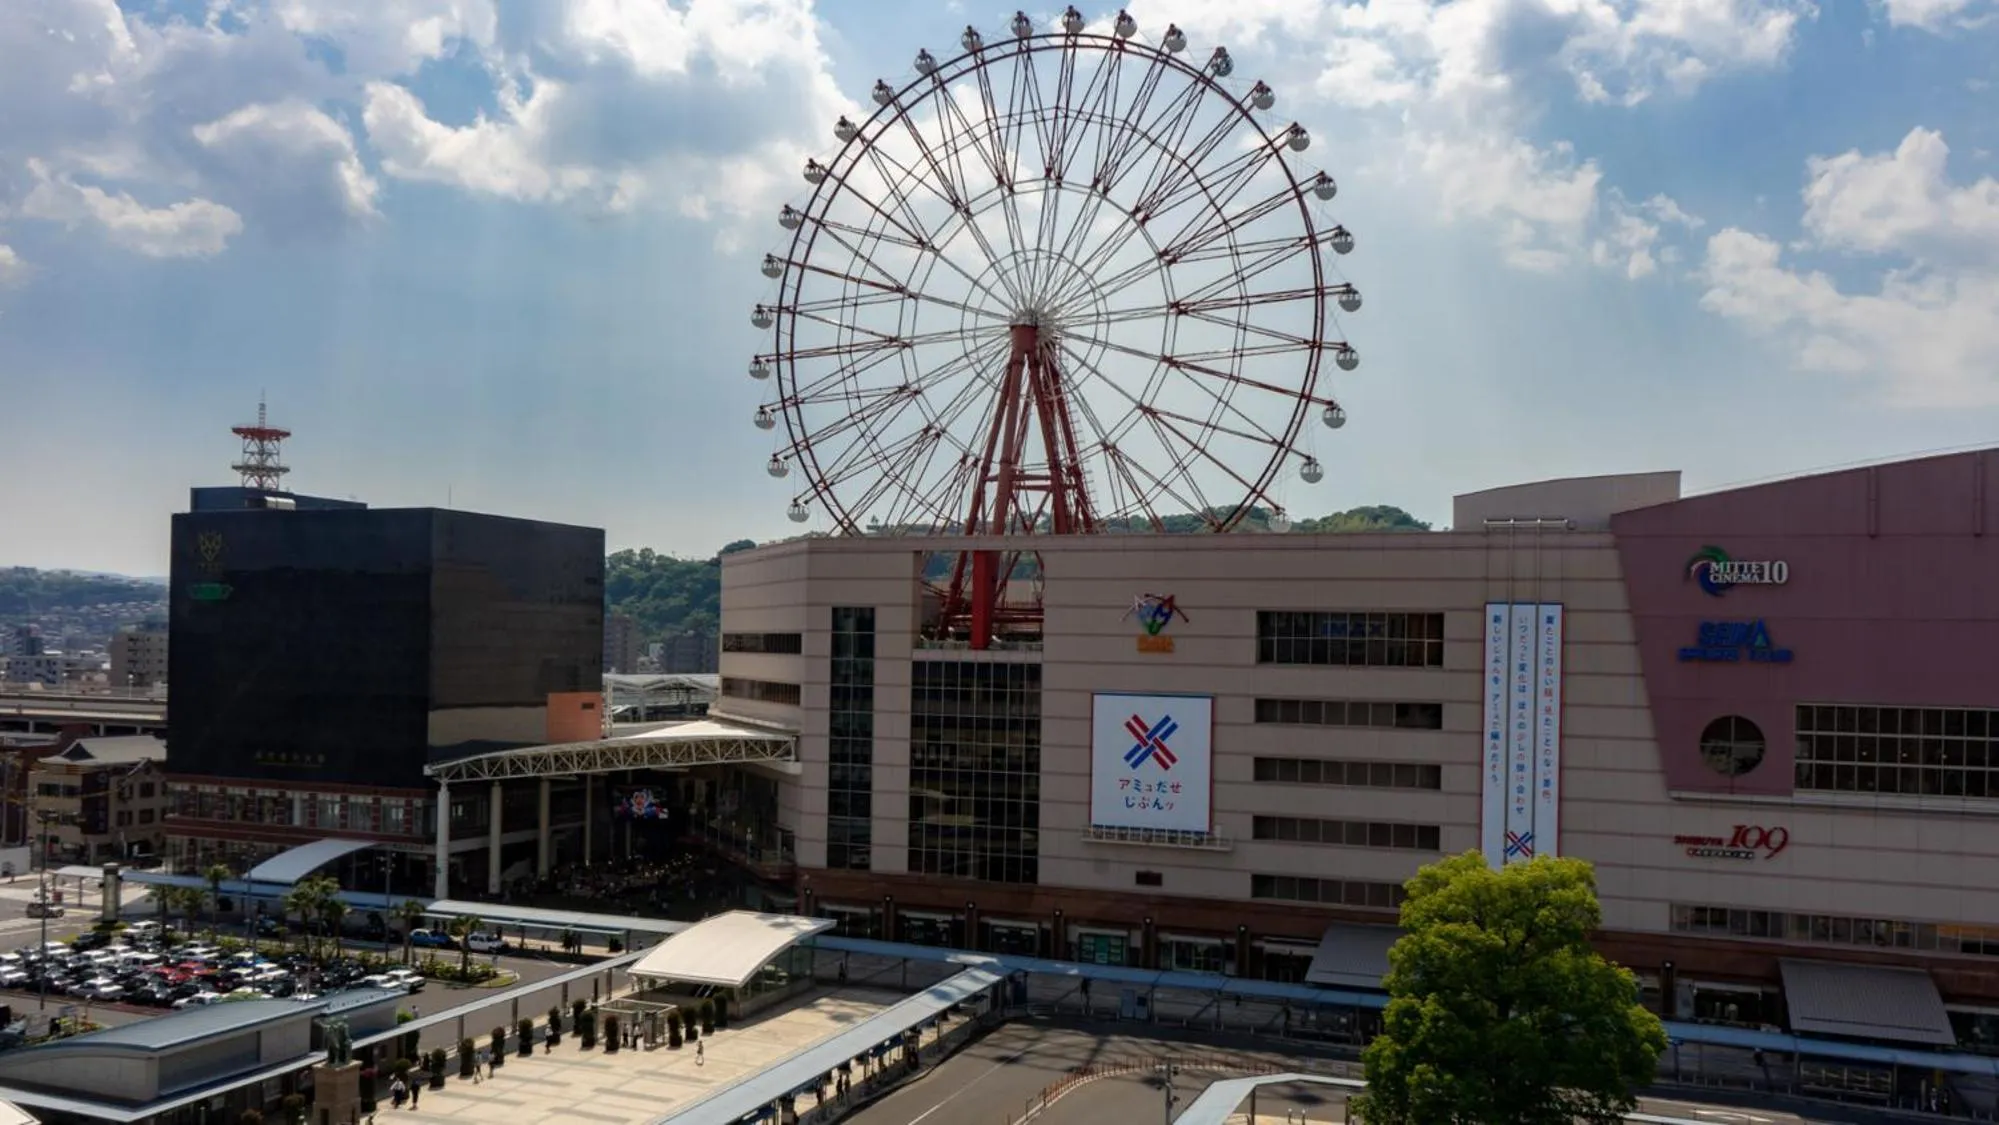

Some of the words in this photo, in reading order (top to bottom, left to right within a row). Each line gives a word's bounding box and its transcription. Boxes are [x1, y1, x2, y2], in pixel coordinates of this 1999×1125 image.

[1709, 561, 1761, 573] MITTE
[1761, 560, 1788, 584] 10
[1709, 574, 1760, 583] CINEMA
[1118, 778, 1182, 793] アミュだせ
[1674, 836, 1723, 846] SHIBUYA
[1726, 825, 1788, 860] 109
